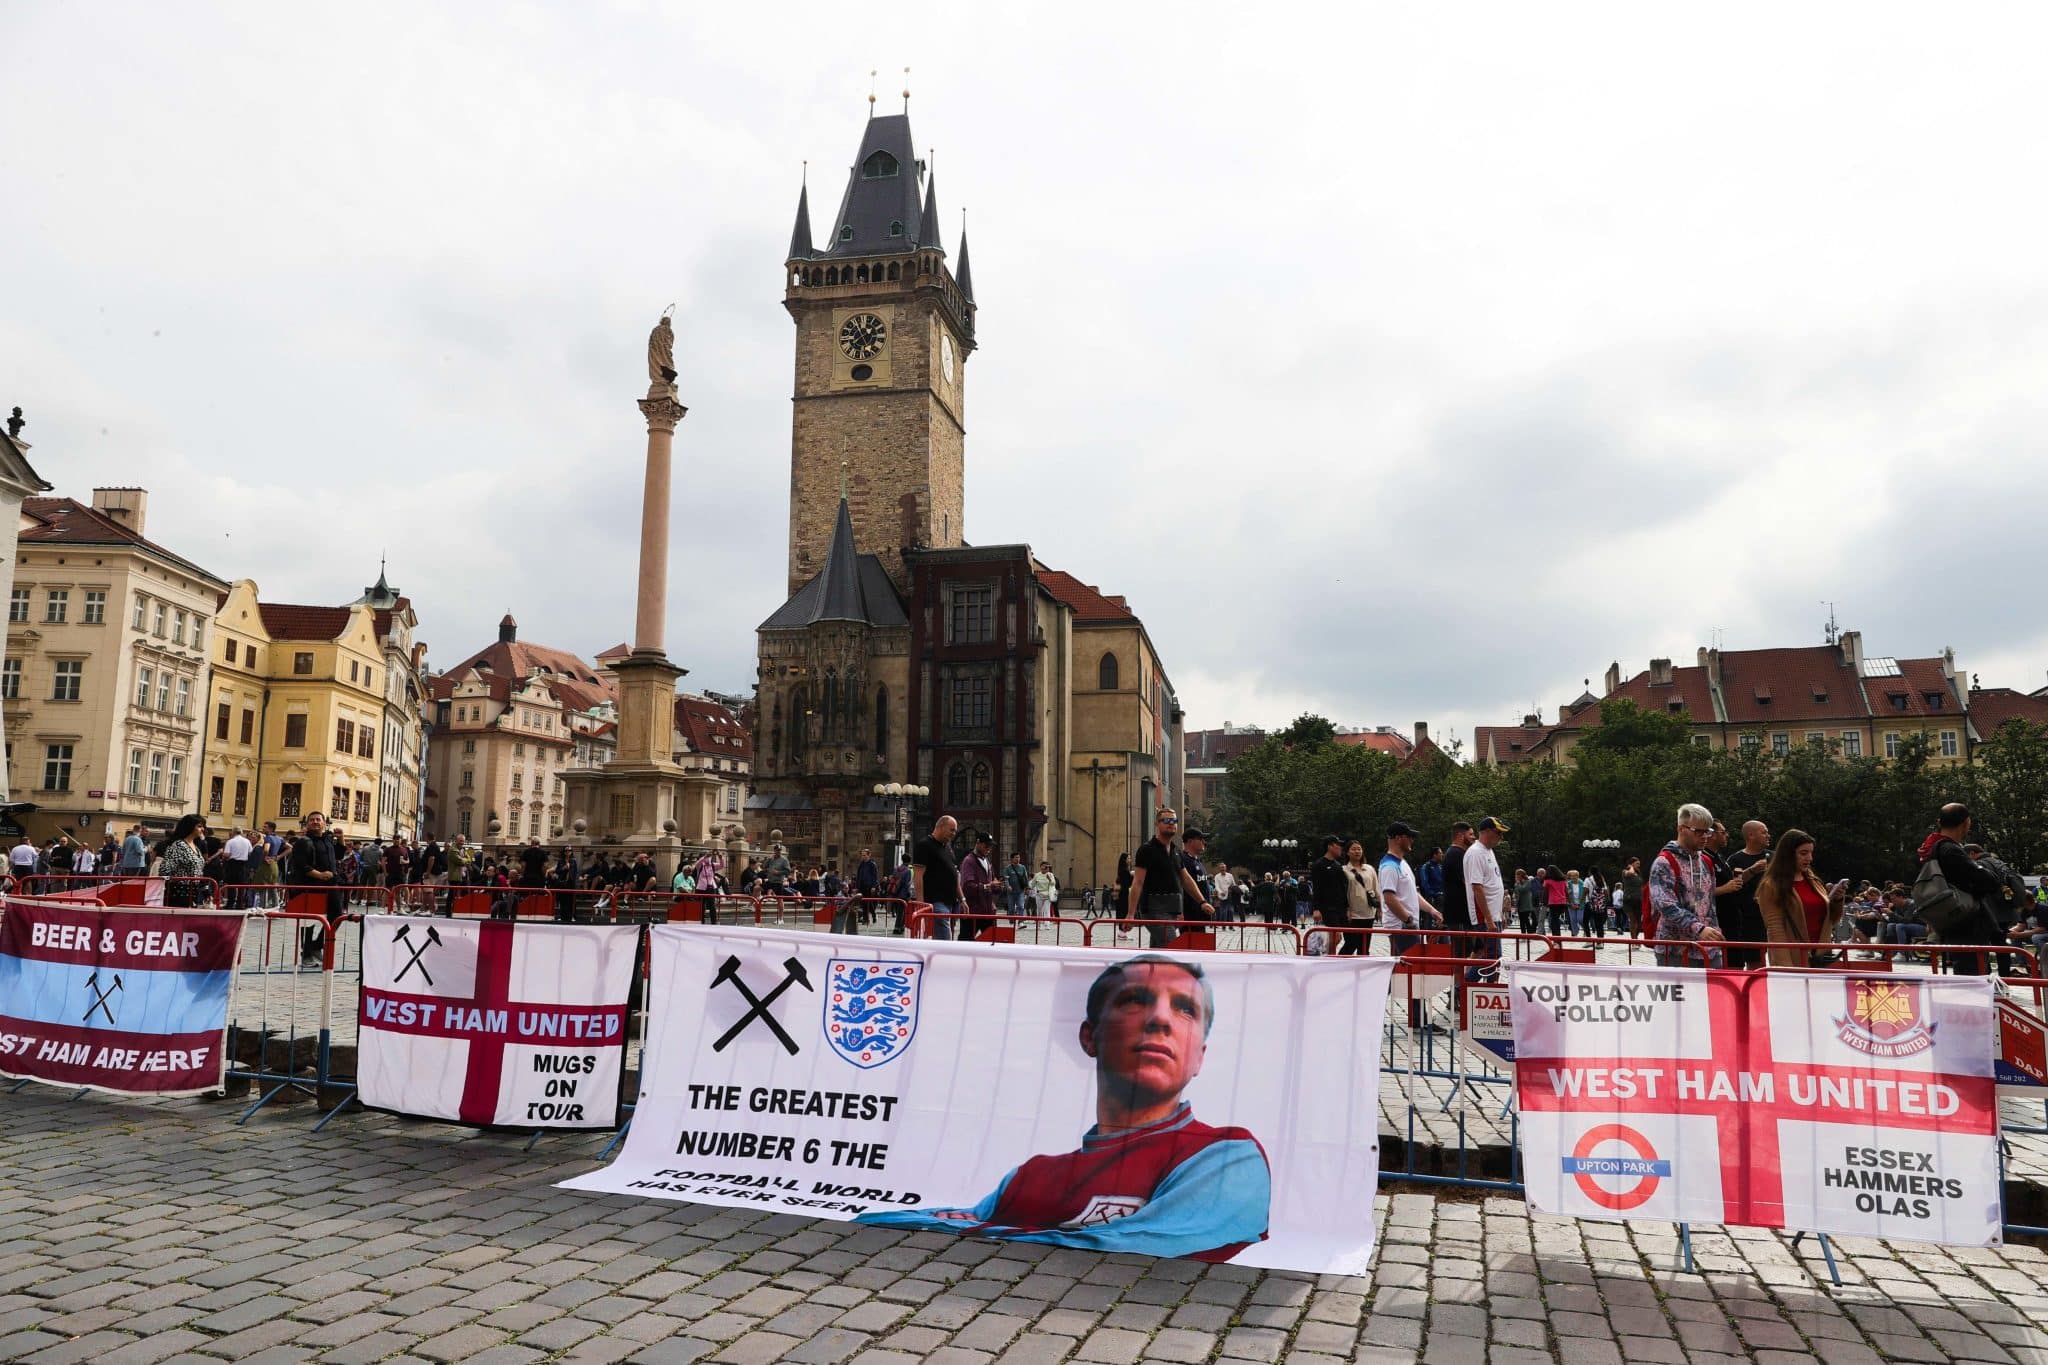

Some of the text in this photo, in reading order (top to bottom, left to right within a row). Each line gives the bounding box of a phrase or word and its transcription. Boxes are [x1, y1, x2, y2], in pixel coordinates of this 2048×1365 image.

[32, 923, 200, 957] BEER & GEAR
[1521, 984, 1685, 1003] YOU PLAY WE
[444, 1006, 507, 1033] HAM
[518, 1011, 619, 1038] UNITED
[1555, 1005, 1654, 1023] FOLLOW
[2002, 1012, 2031, 1036] DAP
[36, 1040, 91, 1066] HAM
[93, 1047, 140, 1070] ARE
[140, 1047, 210, 1071] HERE
[1843, 1030, 1928, 1056] WEST HAM UNITED
[534, 1054, 597, 1074] MUGS
[2014, 1056, 2044, 1079] DAP
[545, 1079, 577, 1098] ON
[1548, 1068, 1960, 1116] WEST HAM UNITED
[527, 1102, 584, 1121] TOUR
[688, 1084, 898, 1122] THE GREATEST
[676, 1131, 888, 1170] NUMBER 6 THE
[1845, 1146, 1935, 1173] ESSEX
[1576, 1160, 1656, 1174] UPTON PARK
[653, 1169, 922, 1206] FOOTBALL WORLD
[1824, 1167, 1963, 1199] HAMMERS
[626, 1180, 870, 1214] HAS EVER SEEN
[1855, 1193, 1931, 1219] OLAS
